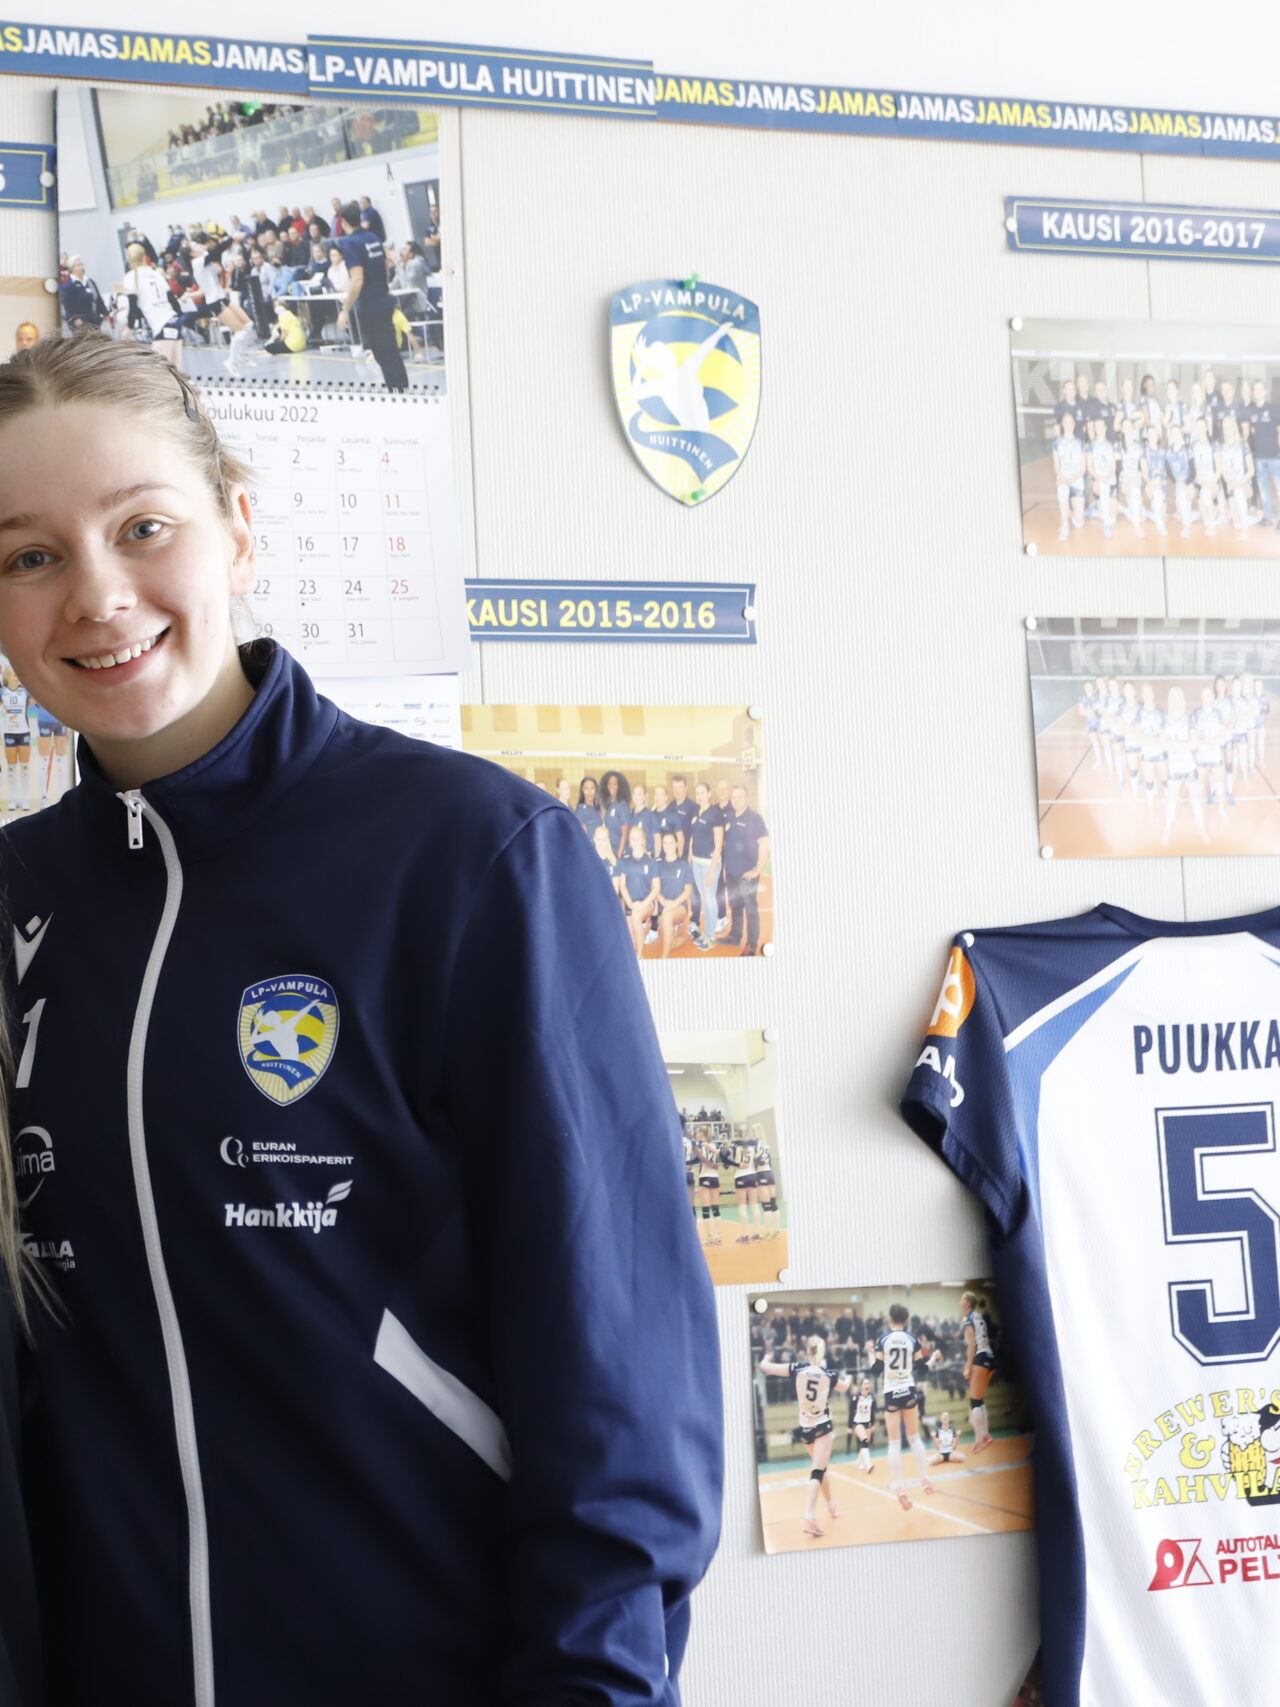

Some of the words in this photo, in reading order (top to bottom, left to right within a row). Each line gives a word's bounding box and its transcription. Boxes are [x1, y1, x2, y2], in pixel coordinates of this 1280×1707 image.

[21, 27, 118, 59] JAMAS
[117, 34, 212, 65] JAMAS
[212, 42, 304, 73] JAMAS
[309, 53, 495, 93] LP-VAMPULA
[502, 66, 656, 107] HUITTINEN
[654, 78, 735, 107] JAMAS
[734, 83, 816, 112] JAMAS
[815, 88, 896, 118] JAMAS
[897, 94, 976, 123] JAMAS
[975, 100, 1052, 127] JAMAS
[1051, 106, 1128, 133] JAMAS
[1128, 111, 1203, 138] JAMAS
[1202, 116, 1276, 144] JAMAS
[1042, 212, 1121, 241] KAUSI
[1130, 216, 1265, 249] 2016-2017
[620, 289, 746, 321] LP-VAMPULA
[280, 405, 319, 423] 2022
[293, 449, 300, 464] 2
[338, 450, 345, 465] 3
[382, 452, 389, 465] 4
[649, 433, 715, 471] HUITTINEN
[294, 492, 302, 507] 9
[340, 494, 357, 509] 10
[386, 494, 400, 509] 11
[298, 536, 314, 551] 16
[343, 537, 359, 552] 17
[389, 537, 406, 552] 18
[253, 580, 271, 594] 22
[299, 580, 316, 595] 23
[345, 580, 362, 595] 24
[391, 580, 409, 595] 25
[559, 599, 716, 630] 2015-2016
[255, 623, 273, 637] 29
[301, 623, 320, 638] 30
[348, 623, 365, 638] 31
[251, 981, 329, 999] LP-VAMPULA
[1132, 1019, 1280, 1075] PUUKKA
[252, 1142, 296, 1151] EURAN
[252, 1153, 354, 1165] ERIKOISPAPERIT
[225, 1201, 338, 1235] Hankkija
[1154, 1101, 1280, 1366] 5
[889, 1347, 909, 1371] 21
[1179, 1432, 1216, 1470] &
